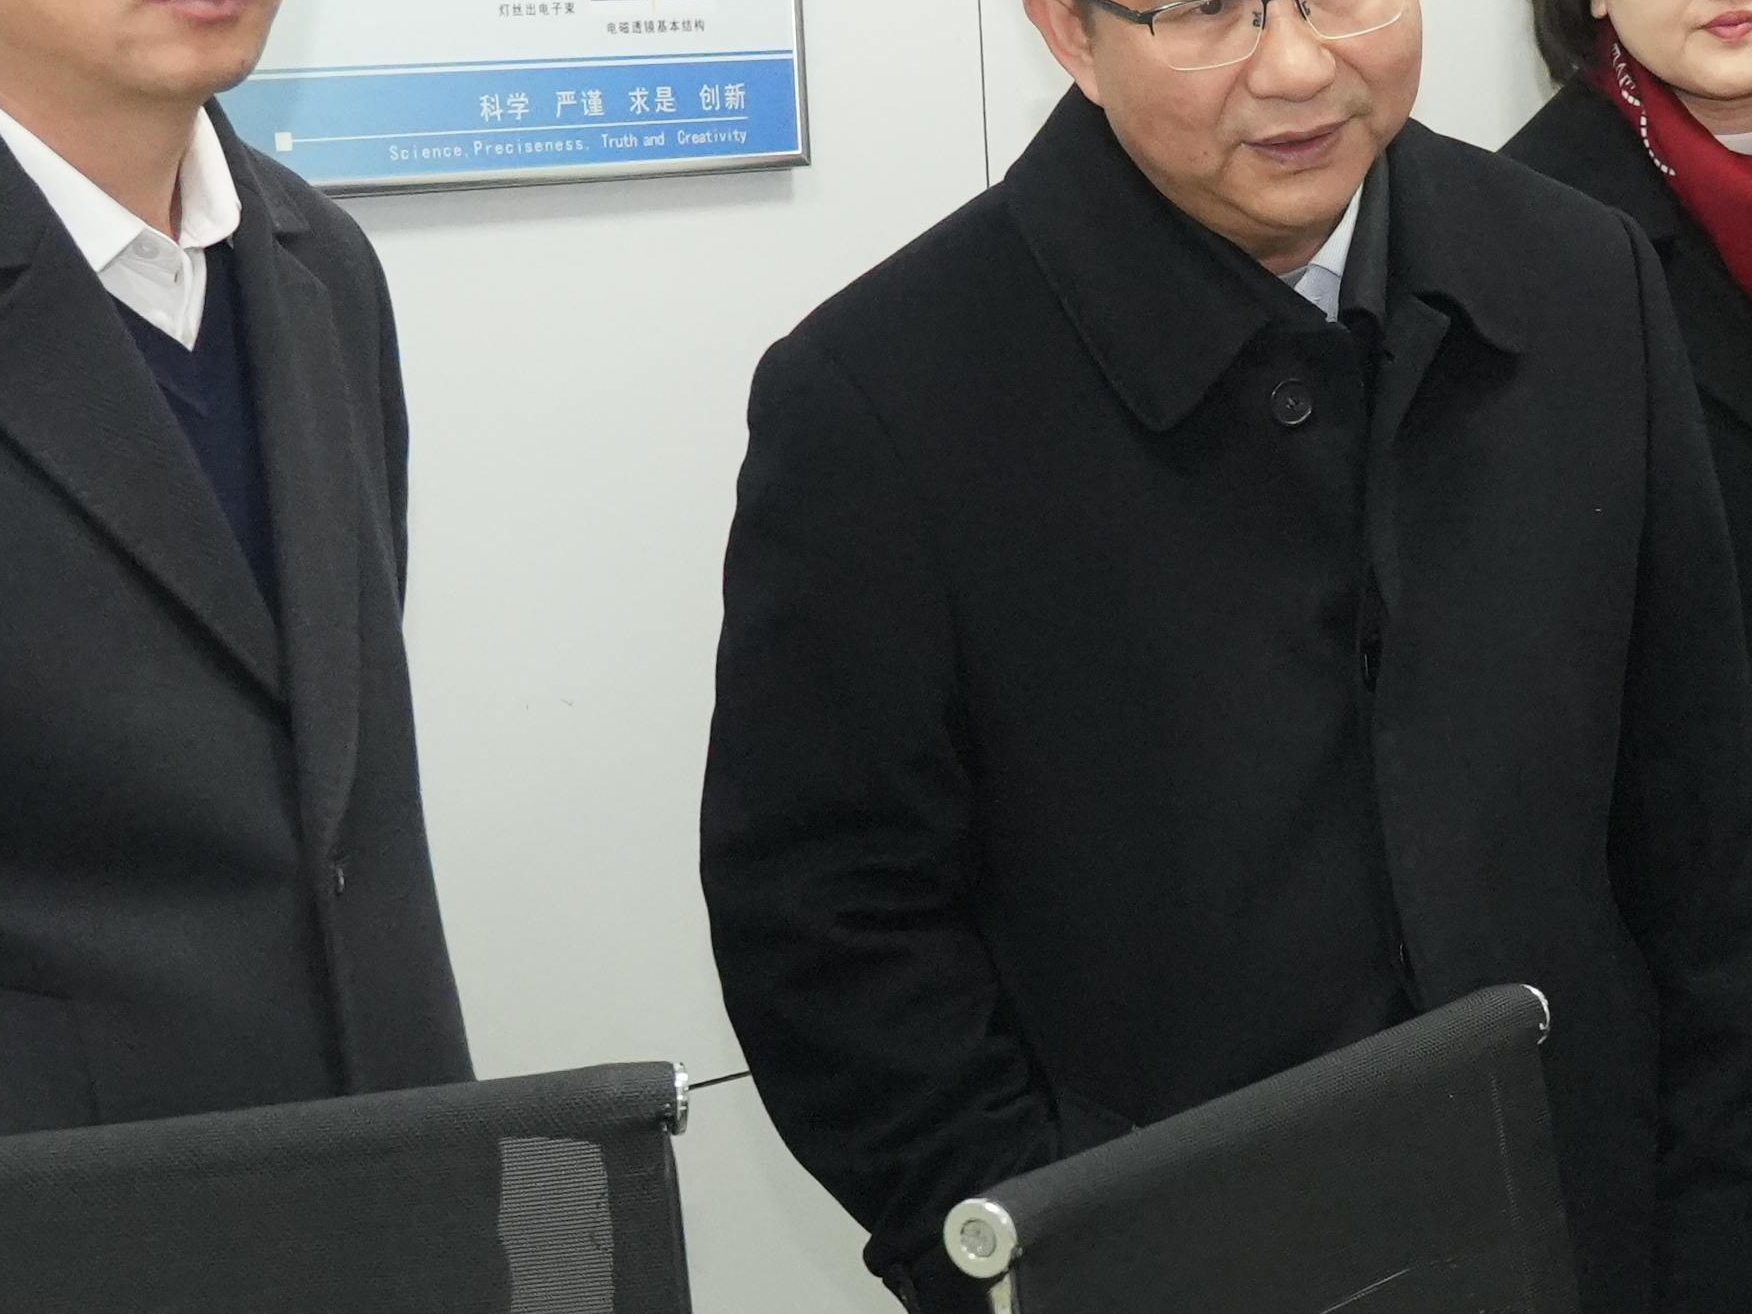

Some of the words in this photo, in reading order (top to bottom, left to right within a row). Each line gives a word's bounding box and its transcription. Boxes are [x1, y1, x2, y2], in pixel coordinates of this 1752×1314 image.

[479, 93, 530, 122] 科学
[555, 90, 605, 119] 严谨
[629, 85, 678, 114] 求是
[698, 82, 747, 111] 创新
[601, 132, 638, 150] Truth
[642, 130, 665, 147] and
[677, 126, 748, 145] Creativity
